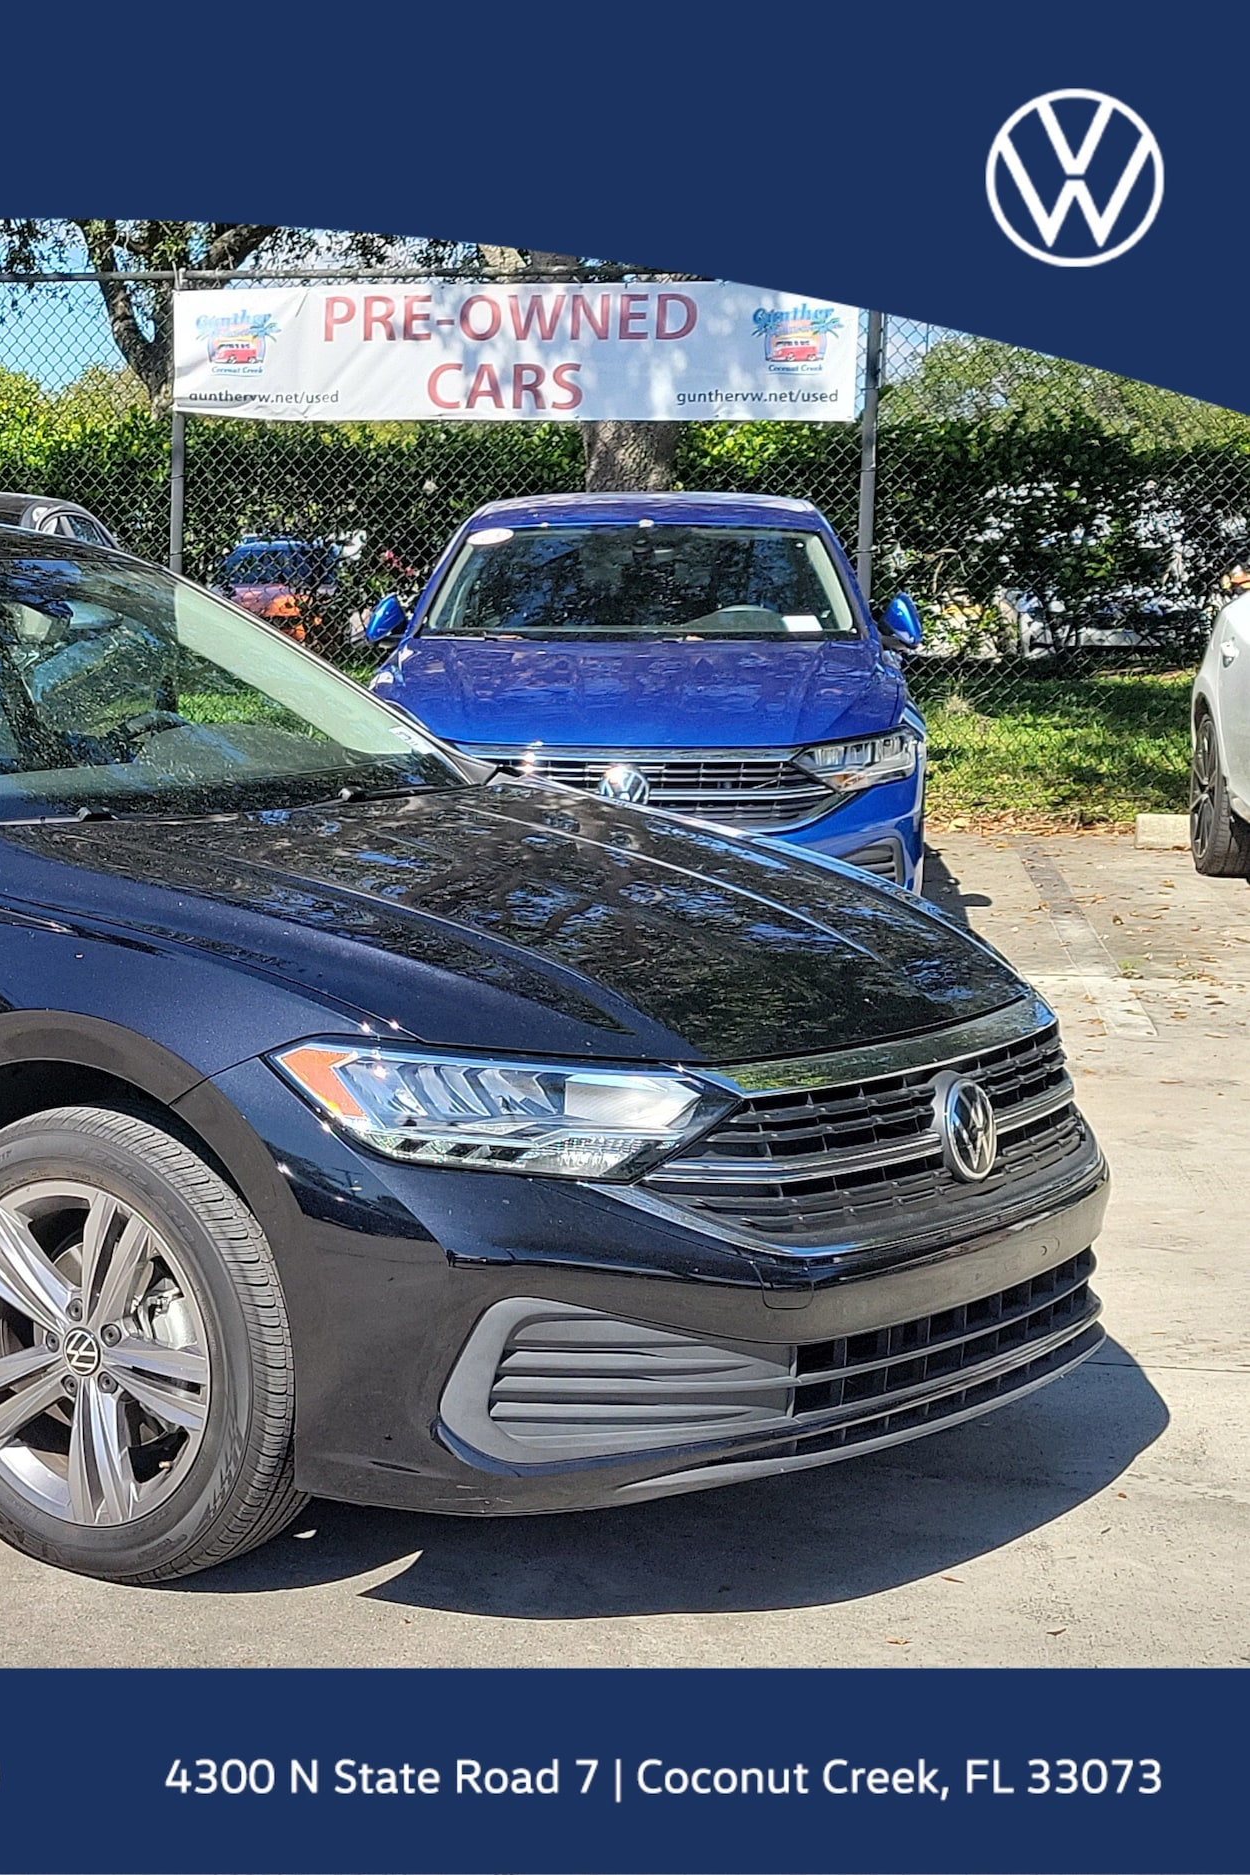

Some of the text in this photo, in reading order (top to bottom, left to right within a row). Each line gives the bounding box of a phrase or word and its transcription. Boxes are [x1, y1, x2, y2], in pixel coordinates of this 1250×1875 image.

[324, 293, 698, 342] PRE-OWNED
[753, 303, 835, 326] Gunther
[427, 362, 583, 410] CARS
[677, 389, 839, 406] gunthervw.net/used
